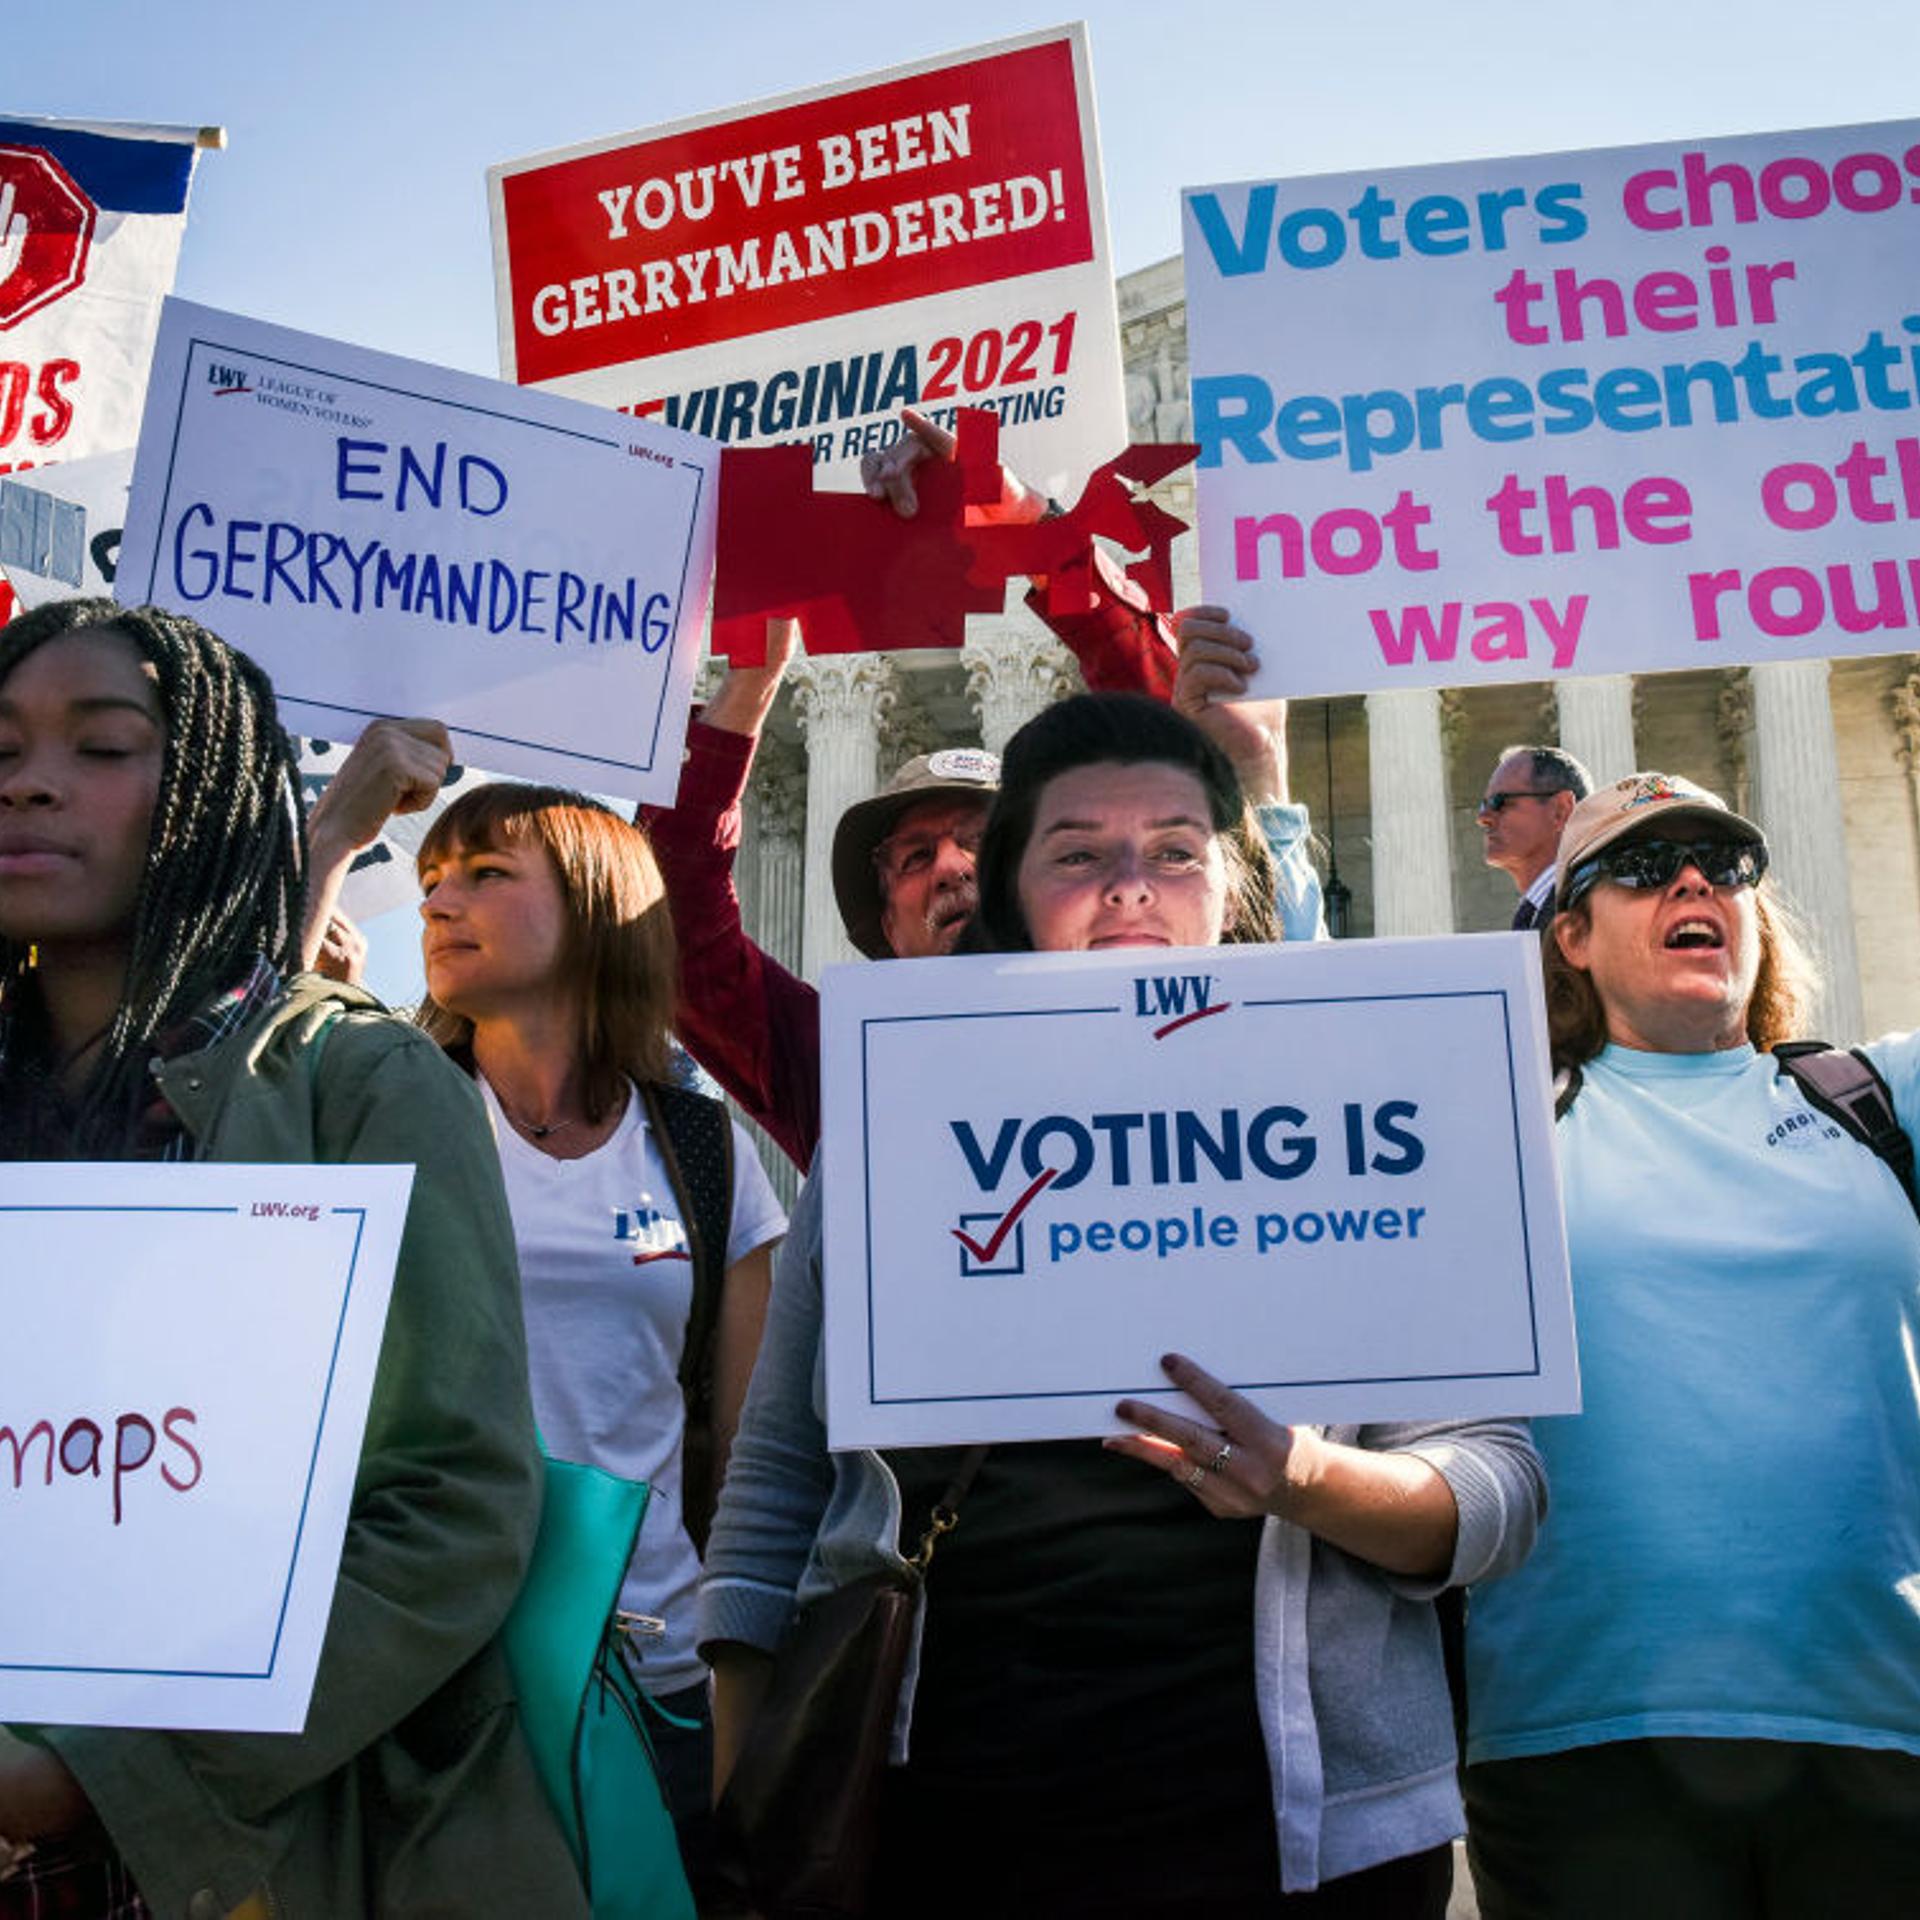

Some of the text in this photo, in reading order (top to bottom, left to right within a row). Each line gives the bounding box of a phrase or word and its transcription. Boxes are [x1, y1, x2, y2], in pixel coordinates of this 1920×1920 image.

[599, 104, 973, 240] YOU'VE BEEN
[531, 168, 1067, 336] GERRYMANDERED!
[1189, 183, 1588, 277] Voters
[1494, 245, 1796, 346] their
[256, 393, 309, 416] WOMEN
[257, 376, 316, 400] LEAGUE
[337, 438, 508, 516] END
[1233, 491, 1439, 580] not
[1486, 474, 1692, 555] the
[174, 503, 671, 653] GERRYMANDERING
[1368, 559, 1920, 669] way rou
[1133, 975, 1211, 1017] LWV
[951, 1100, 1425, 1192] VOTING IS
[250, 1202, 319, 1221] LWV.org
[1049, 1204, 1426, 1262] people power
